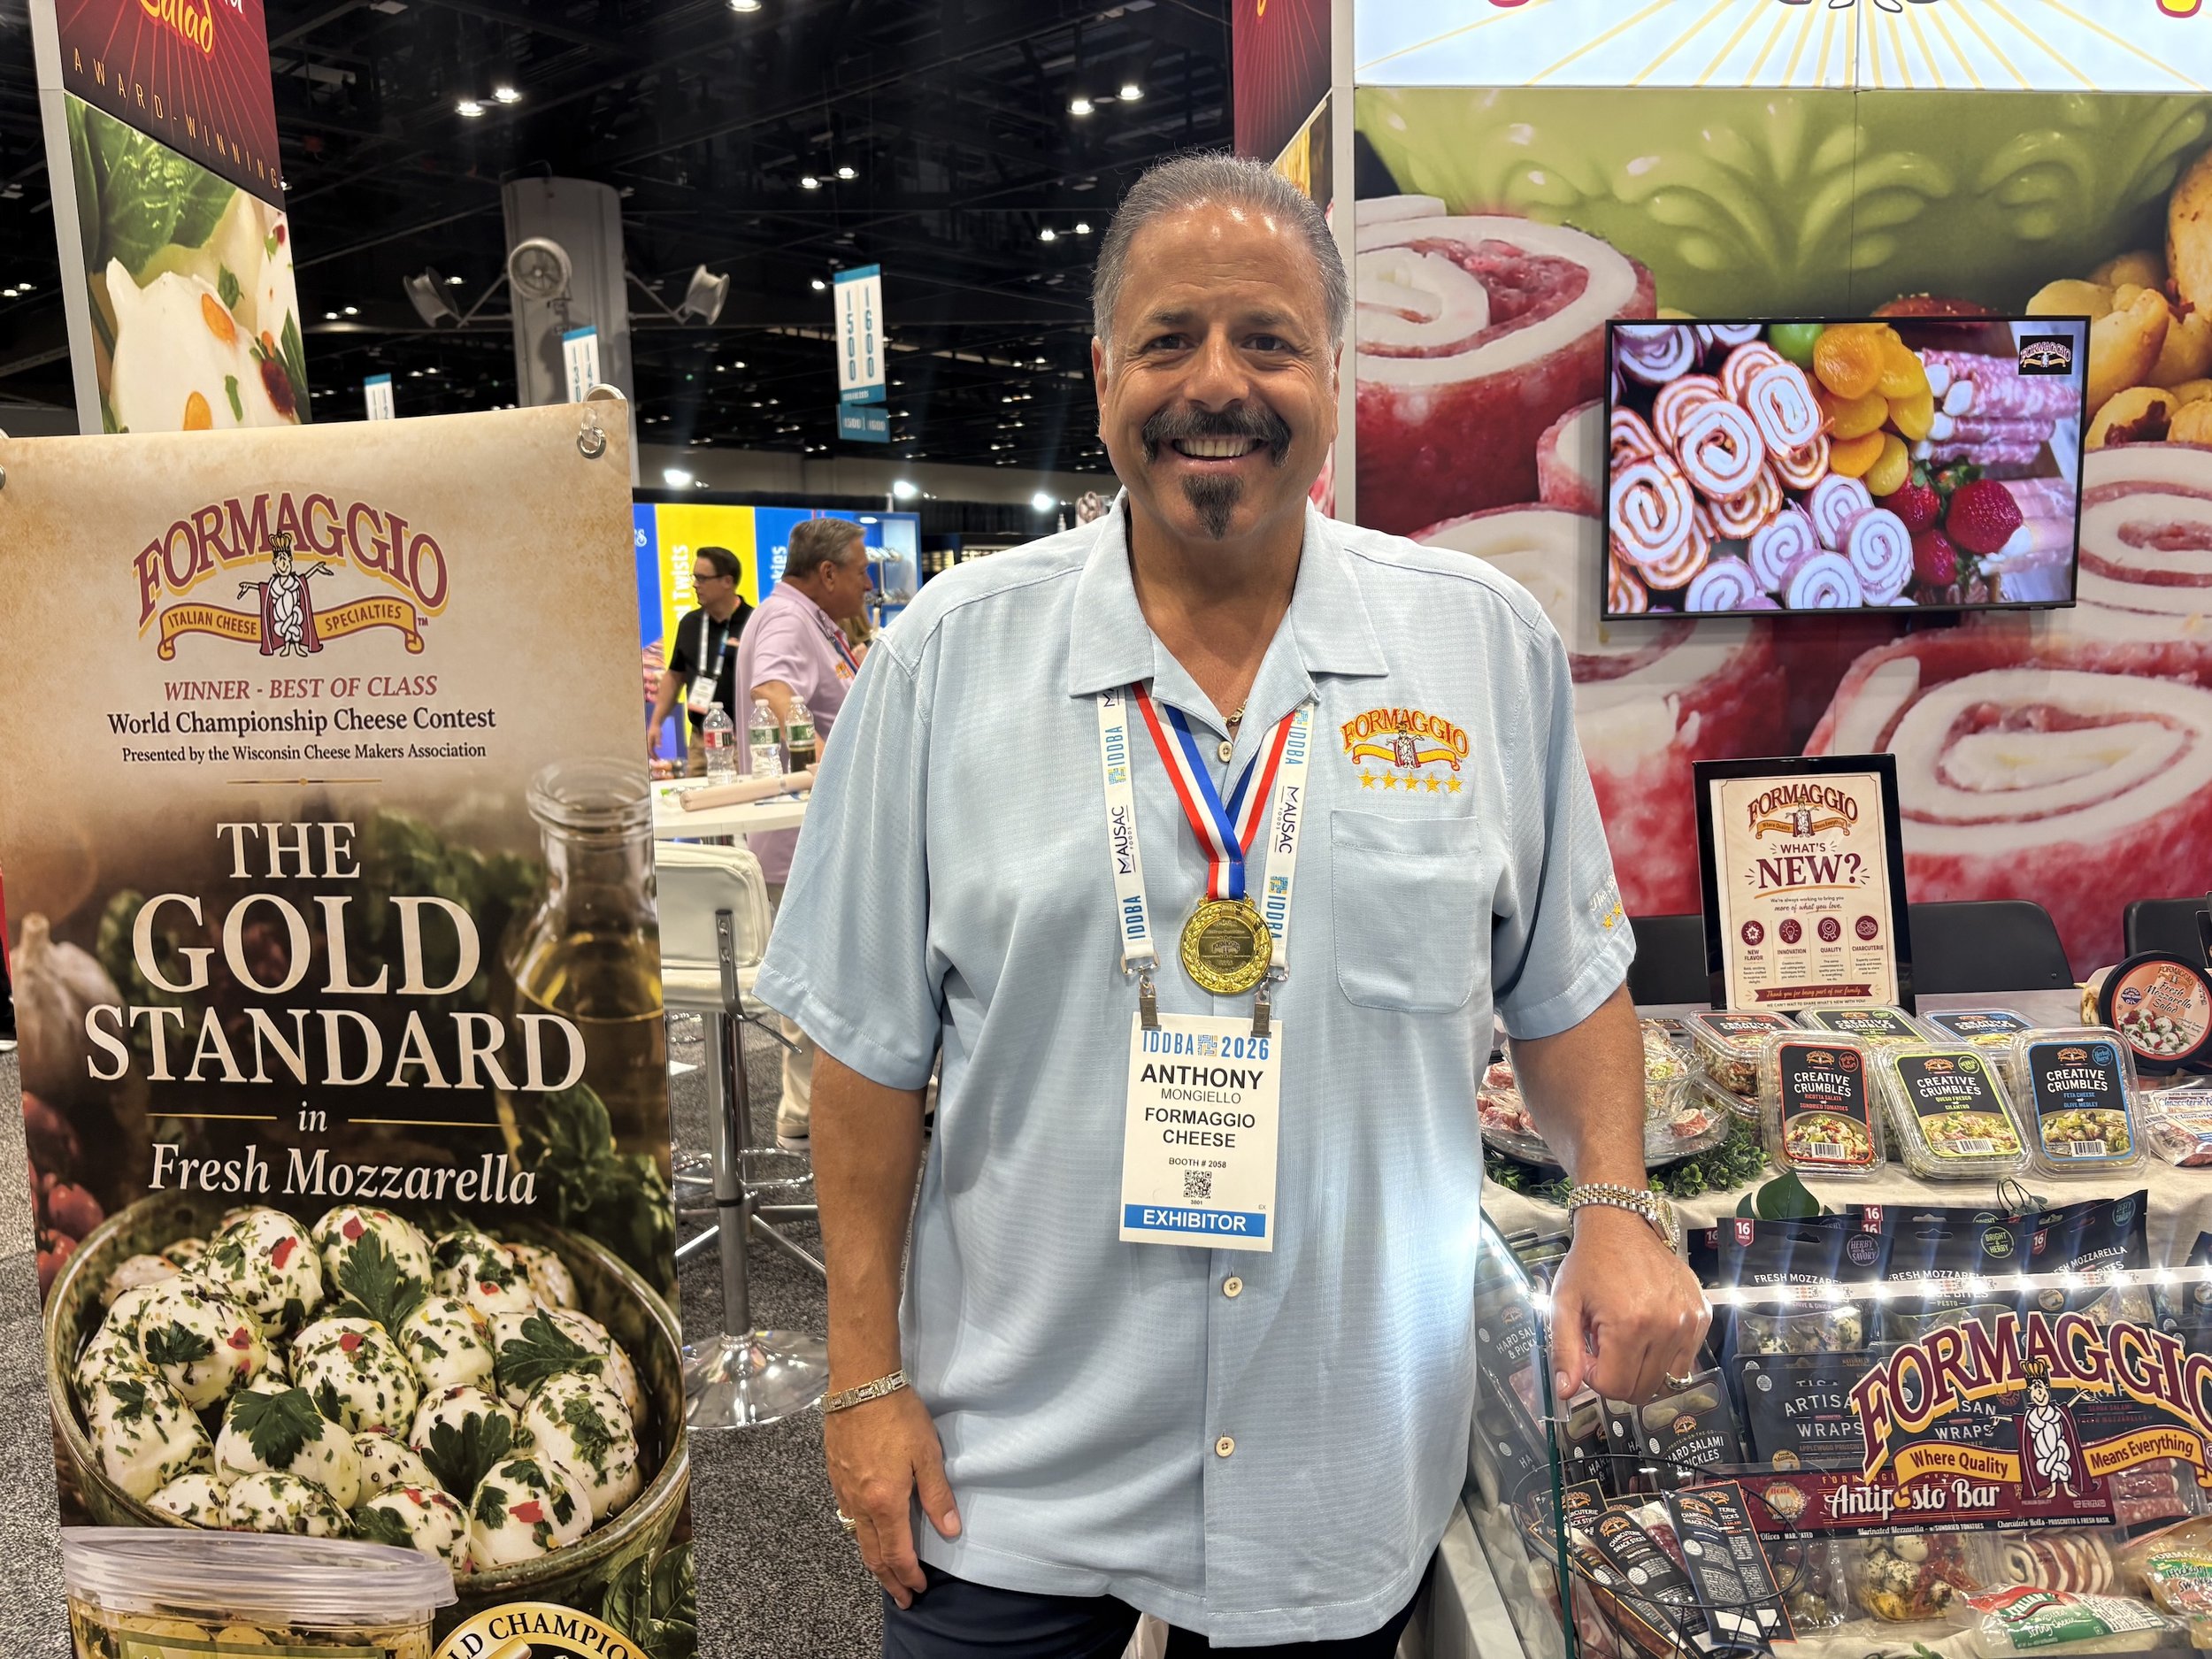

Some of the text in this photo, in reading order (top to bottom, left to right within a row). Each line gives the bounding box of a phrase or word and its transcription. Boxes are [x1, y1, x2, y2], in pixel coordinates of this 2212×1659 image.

[847, 290, 856, 381] 1500
[864, 285, 874, 378] 1600
[134, 492, 449, 634] FORMAGGIO
[168, 605, 402, 636] ITALIAN CHEESE SPECIALTIES
[164, 675, 438, 701] WINNER BEST OF CLASS
[107, 707, 496, 738] World Championship Cheese Contest
[1340, 708, 1470, 757] FORMAGGIO
[122, 742, 486, 764] Presented by the Wisconsin Cheese Makers Association
[1105, 726, 1125, 767] IDDBA
[1285, 727, 1308, 765] IDDBA
[1747, 784, 1858, 830] FORMAGGIO
[1279, 787, 1300, 854] MAUSAC
[216, 821, 361, 879] THE
[1111, 805, 1133, 874] MAUSAC
[1780, 843, 1826, 854] WHAT'S
[1755, 853, 1862, 888] NEW?
[1123, 895, 1146, 941] IDDBA
[132, 893, 480, 995] GOLD
[2144, 985, 2192, 1010] Mozzarella
[2159, 981, 2185, 997] Fresh
[2152, 998, 2178, 1014] Salad
[85, 1003, 586, 1092] STANDARD
[1143, 1031, 1269, 1060] IDDBA 2026
[1141, 1064, 1263, 1090] ANTHONY
[1793, 1071, 1850, 1087] CREATIVE
[1916, 1076, 1977, 1088] CREATIVE
[2047, 1068, 2106, 1081] CREATIVE
[1161, 1088, 1241, 1104] MONGIELLO
[1793, 1083, 1852, 1097] CRUMBLES
[1919, 1086, 1982, 1097] CRUMBLES
[2047, 1079, 2108, 1093] CRUMBLES
[298, 1100, 326, 1133] in
[1145, 1108, 1256, 1128] FORMAGGIO
[1163, 1130, 1236, 1148] CHEESE
[1169, 1157, 1226, 1169] BOOTH 2058
[148, 1143, 537, 1205] Fresh Mozzarella
[1143, 1209, 1247, 1231] EXHIBITOR
[1865, 1207, 1879, 1219] 16
[1736, 1222, 1750, 1234] 16
[1863, 1223, 1877, 1233] 16
[1985, 1232, 2007, 1241] BRIGHT
[1850, 1240, 1873, 1249] HERBY
[1989, 1245, 2008, 1254] HERBY
[2033, 1233, 2044, 1245] 16
[1852, 1251, 1877, 1261] SAVORY
[2071, 1246, 2128, 1267] MOZZARELLA
[1755, 1273, 1787, 1284] FRESH
[1496, 1326, 1536, 1354] HARD SAL
[1785, 1394, 1852, 1417] ARTISA
[1796, 1422, 1863, 1437] WRAPS
[1935, 1424, 1993, 1440] WRAPS
[1690, 1436, 1724, 1453] SALAMI
[1910, 1433, 2193, 1480] Where Quality Means Everything
[1824, 1478, 2000, 1521] Antipsto Bar
[1997, 1519, 2028, 1528] Charcuterie
[1609, 1531, 1642, 1548] CHARCUTERIE
[1613, 1541, 1631, 1553] SNACK
[2168, 1564, 2208, 1578] Hickory
[2007, 1593, 2047, 1617] ITALIAN
[448, 1613, 639, 1659] LD CHAMPIO
